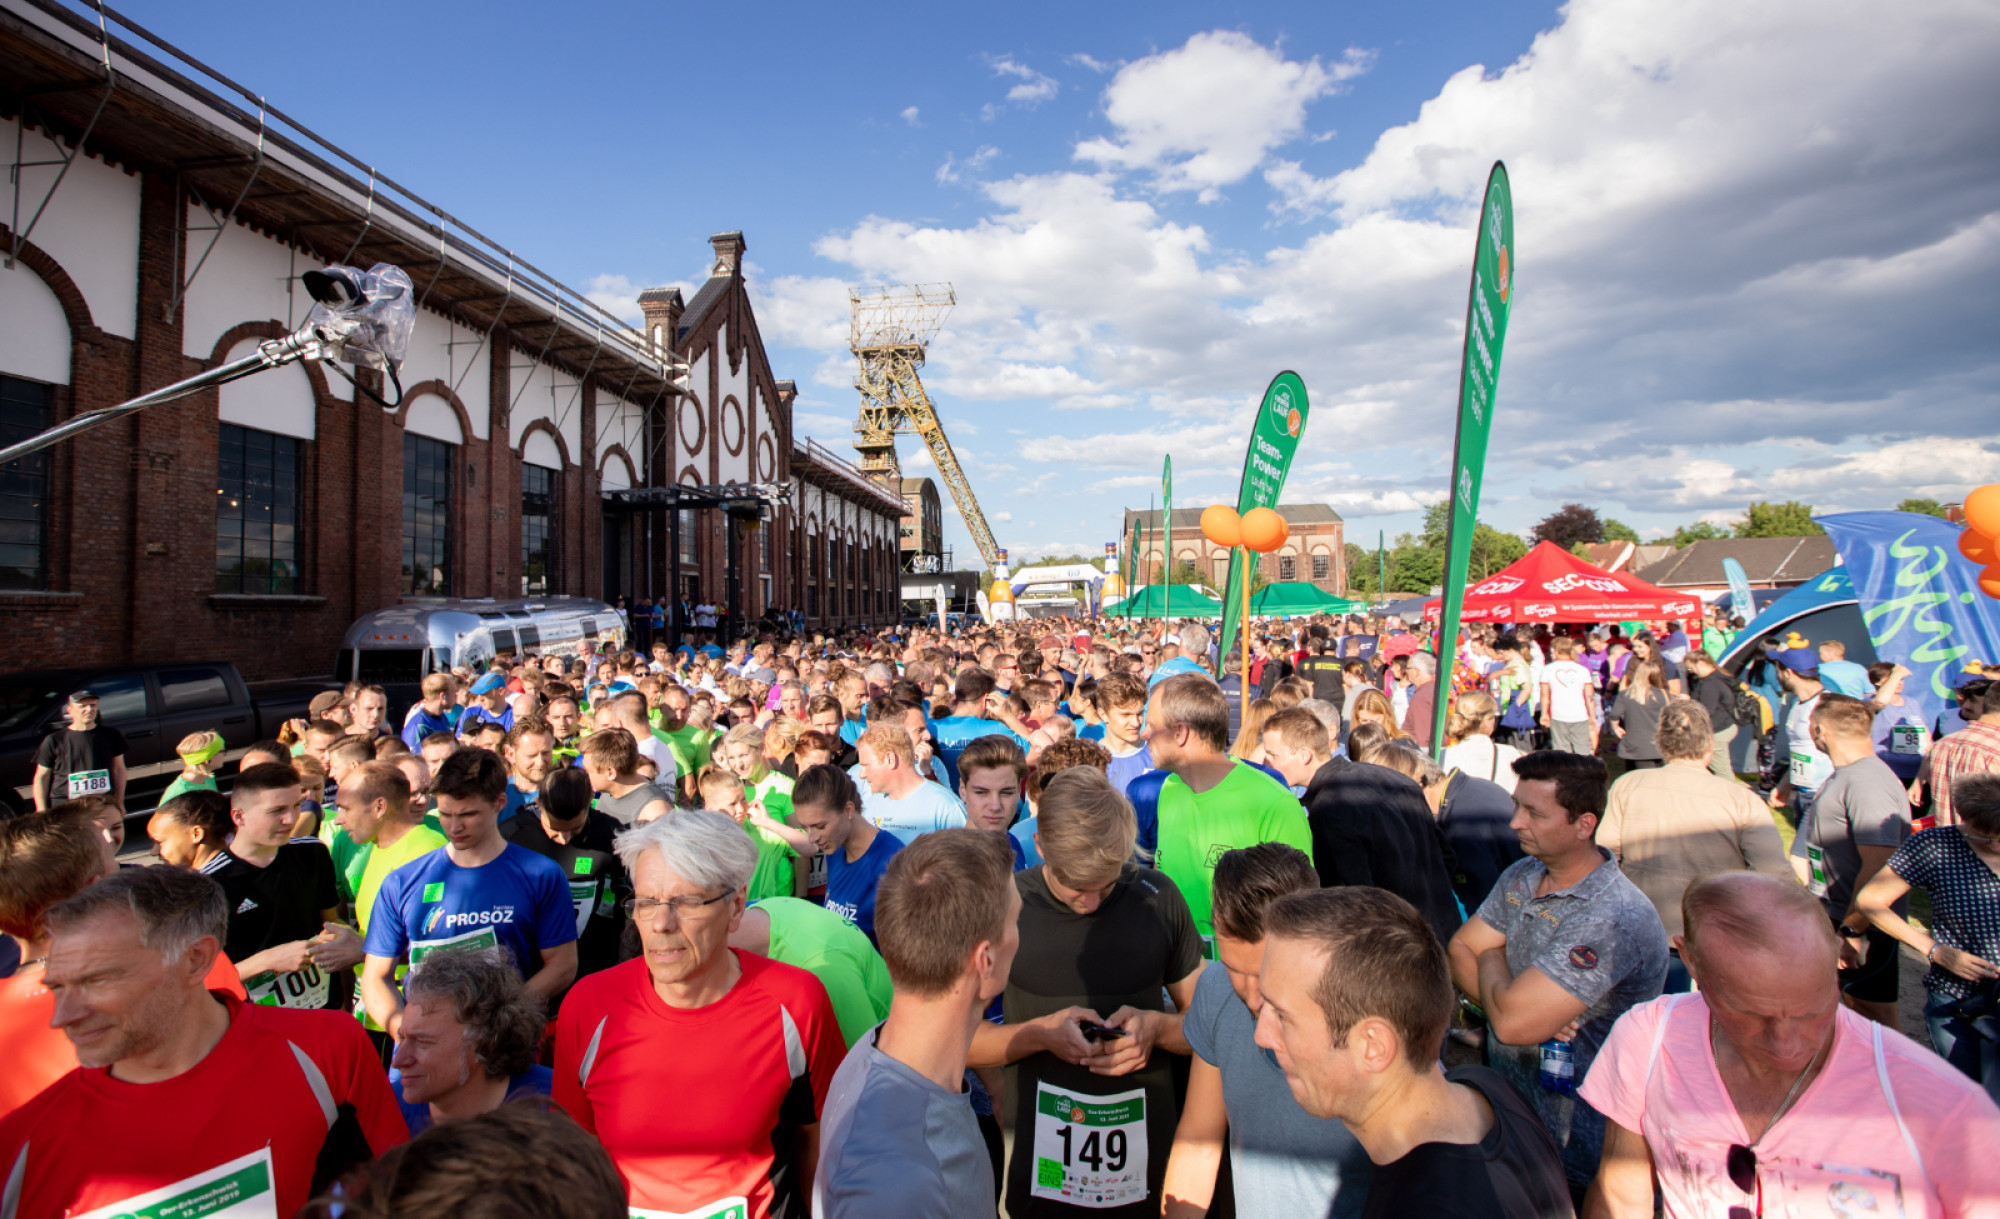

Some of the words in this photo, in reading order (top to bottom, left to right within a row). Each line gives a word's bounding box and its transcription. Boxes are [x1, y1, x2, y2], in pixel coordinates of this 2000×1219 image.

[1257, 434, 1283, 461] Team-
[1253, 453, 1281, 481] Power
[73, 777, 106, 791] 1188
[268, 963, 321, 1006] 100
[1056, 1125, 1127, 1172] 149
[1038, 1172, 1061, 1186] EINS
[159, 1181, 239, 1217] Oer-Erkenschwick
[198, 1199, 217, 1213] Juni
